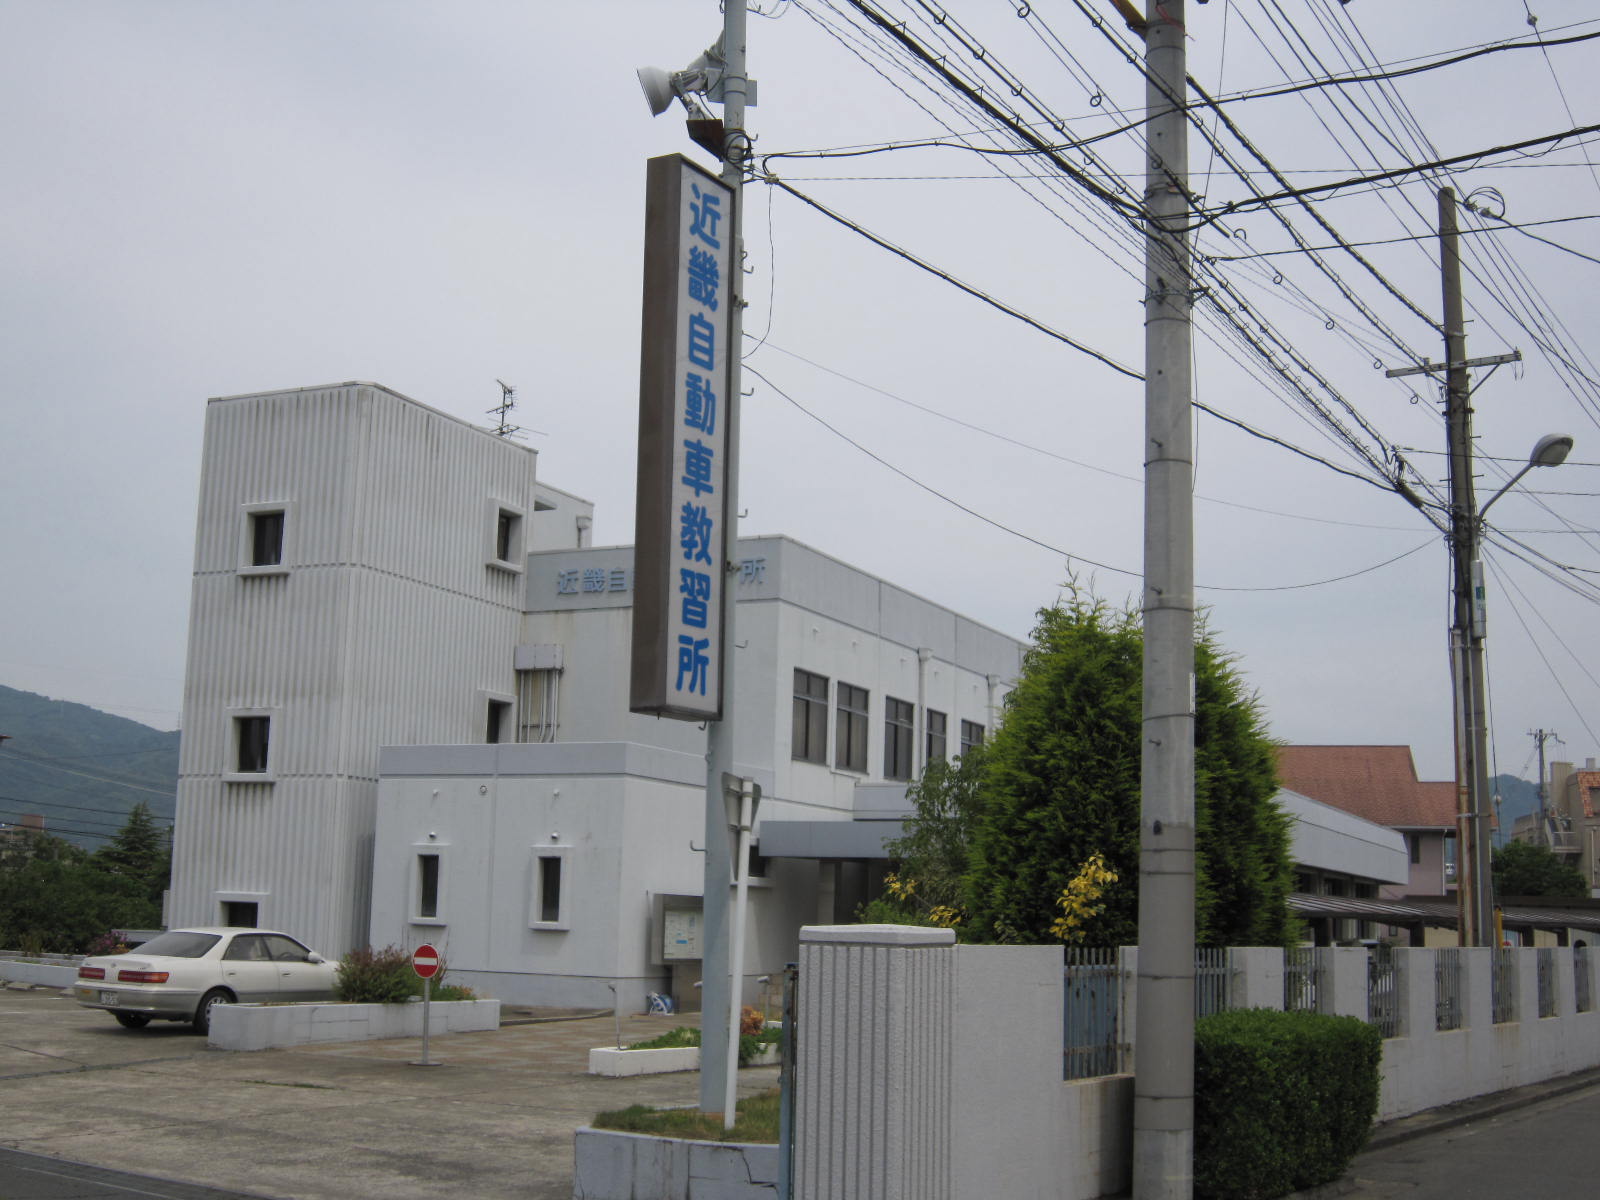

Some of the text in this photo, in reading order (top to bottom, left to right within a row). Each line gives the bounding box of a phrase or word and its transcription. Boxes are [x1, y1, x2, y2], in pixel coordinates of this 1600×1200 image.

[676, 182, 722, 696] 近畿自動車教習所
